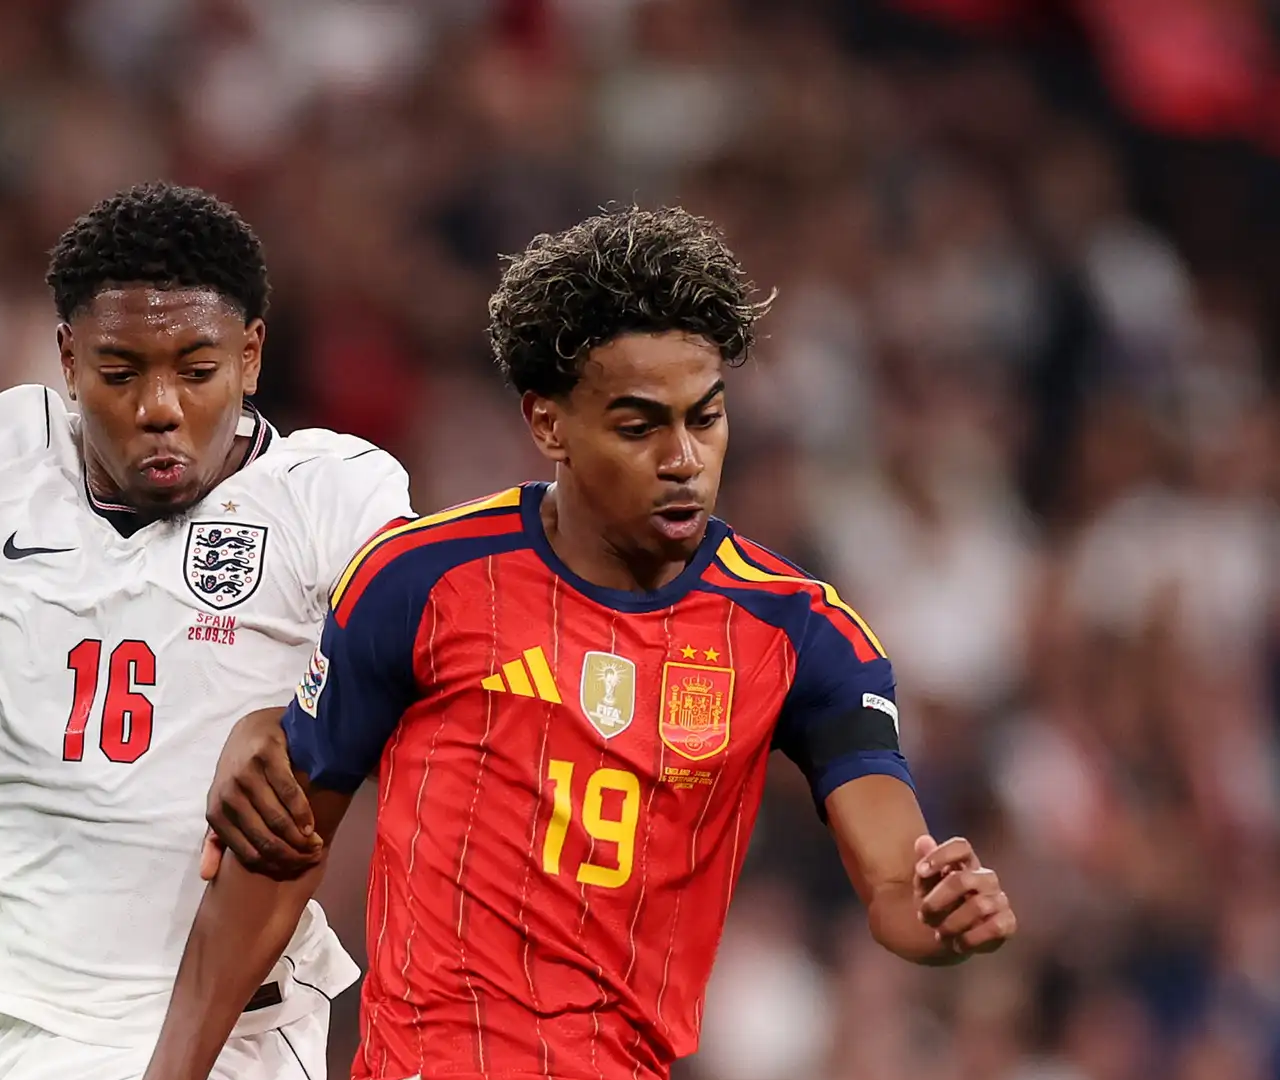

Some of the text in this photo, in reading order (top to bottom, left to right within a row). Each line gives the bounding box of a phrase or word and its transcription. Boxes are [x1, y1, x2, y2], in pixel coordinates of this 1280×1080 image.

[187, 626, 236, 646] 26.09.26
[196, 612, 236, 629] SPAIN
[62, 638, 156, 764] 16
[542, 758, 640, 889] 19
